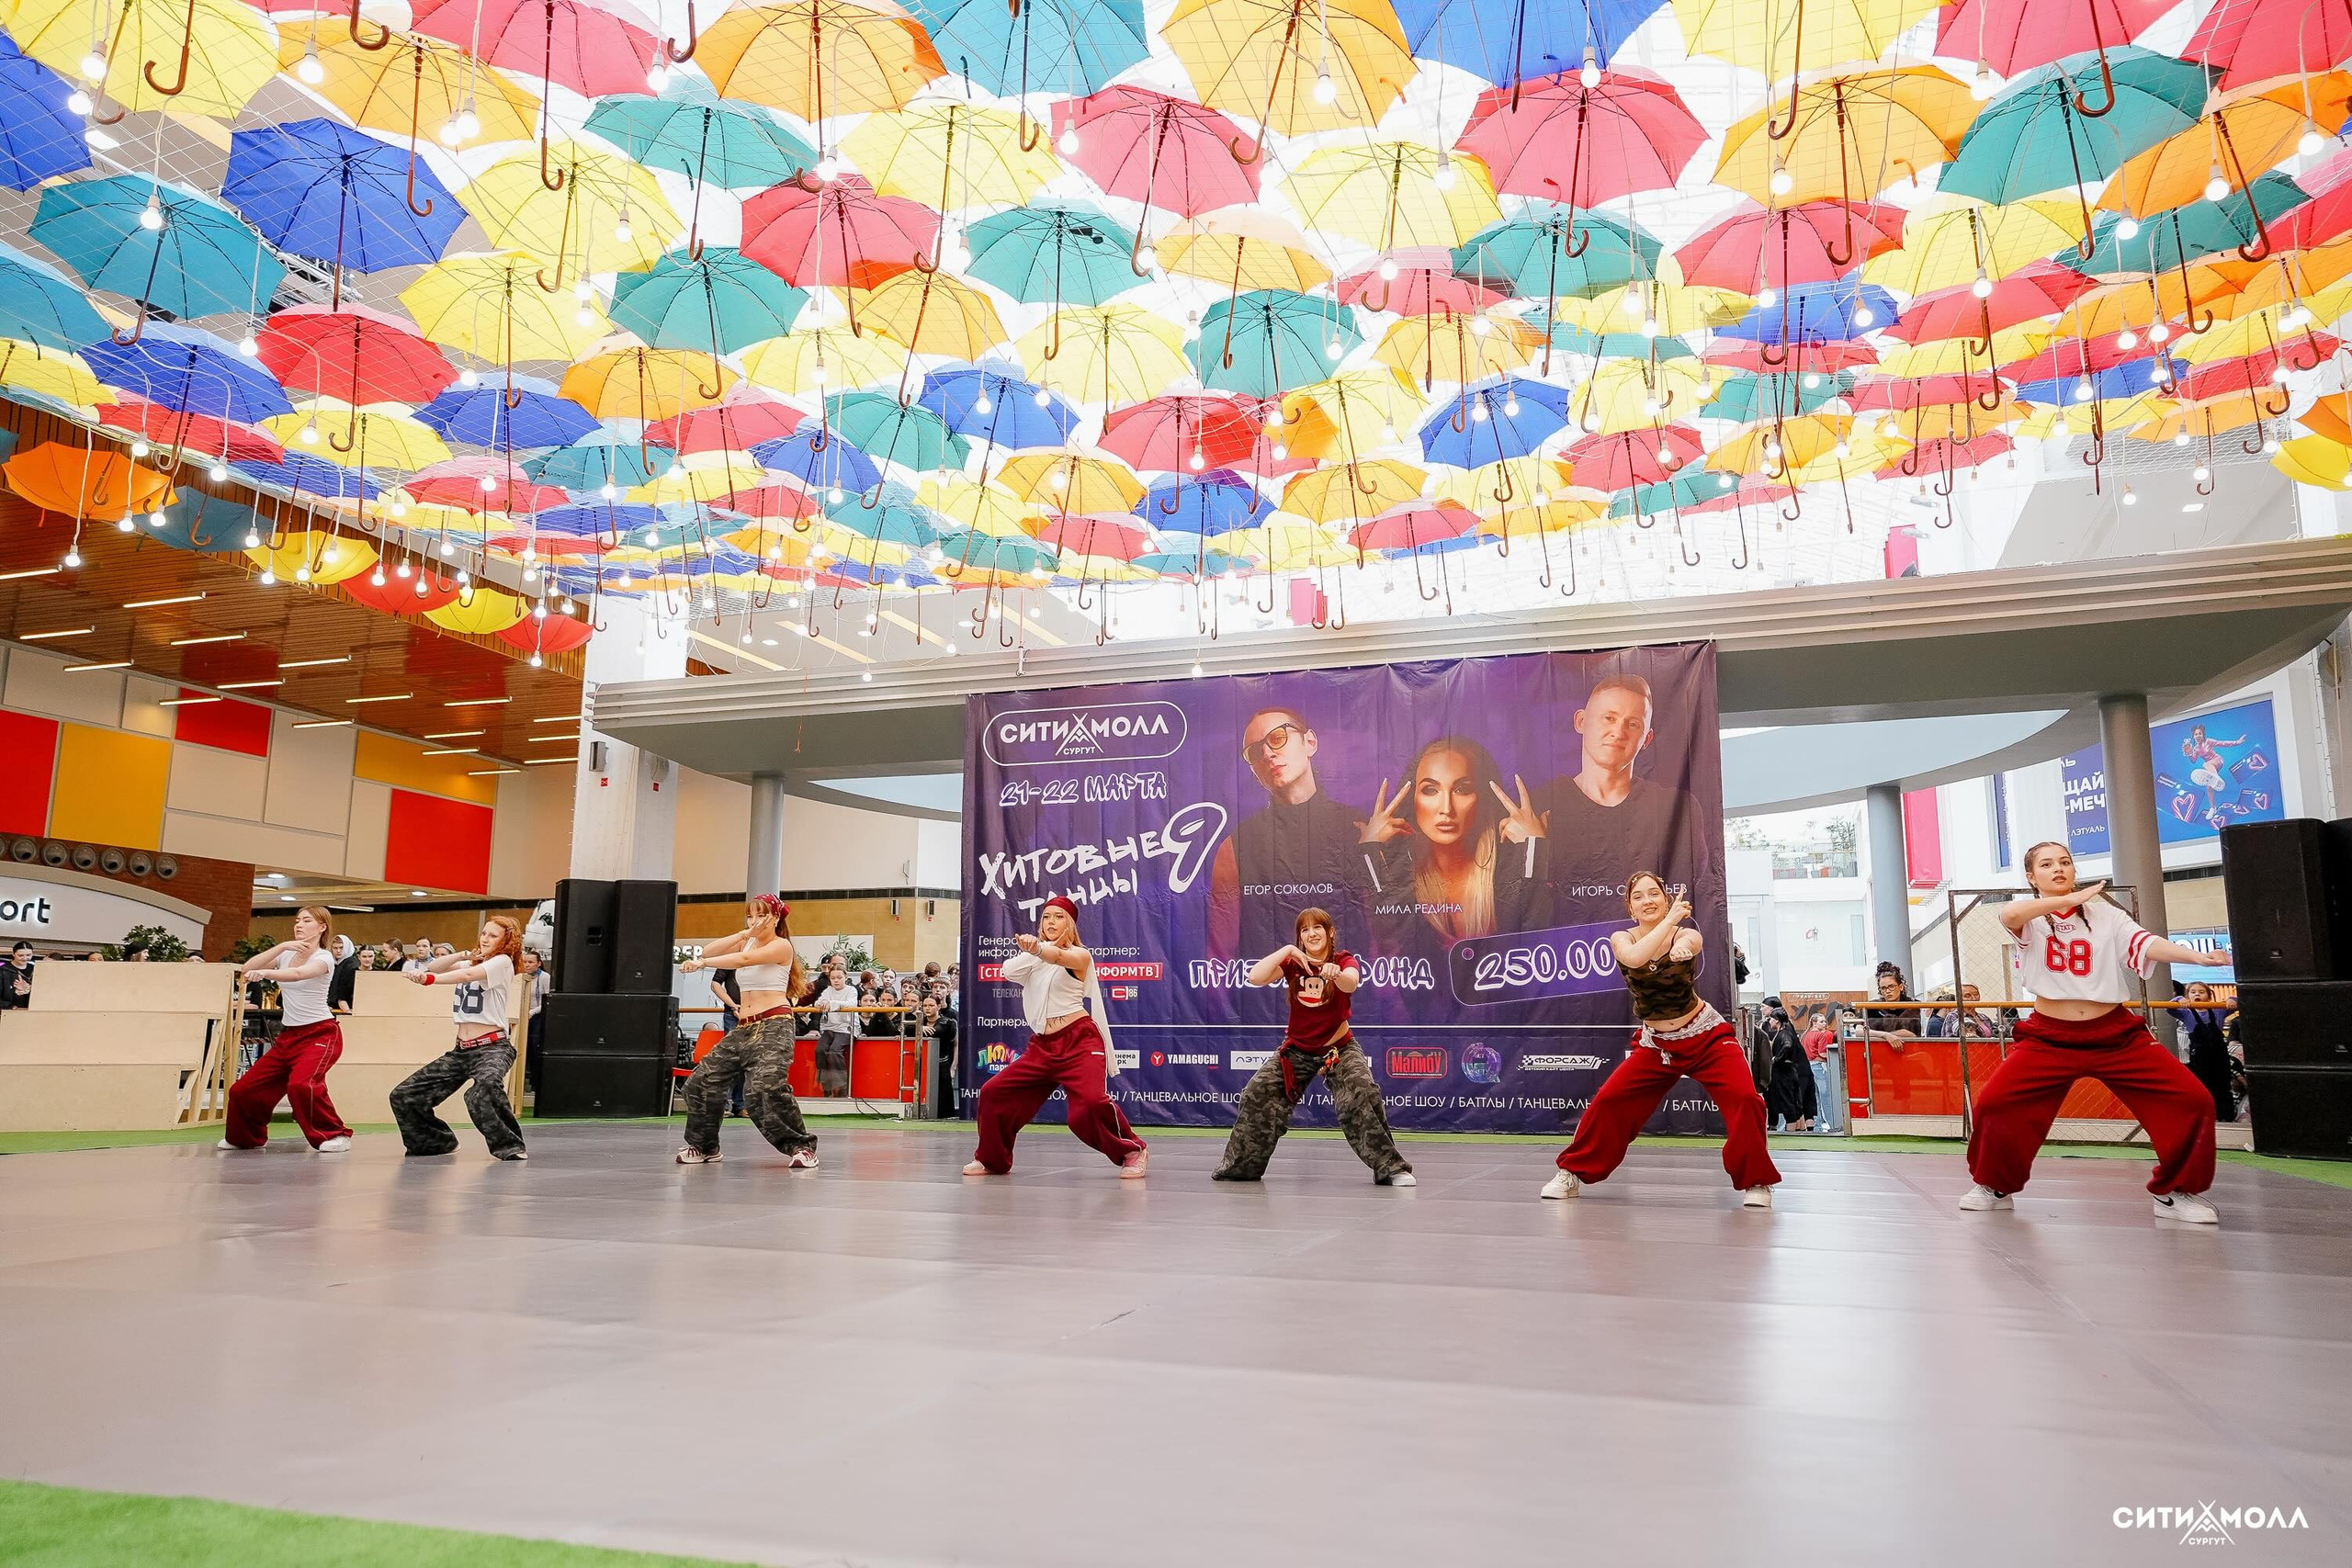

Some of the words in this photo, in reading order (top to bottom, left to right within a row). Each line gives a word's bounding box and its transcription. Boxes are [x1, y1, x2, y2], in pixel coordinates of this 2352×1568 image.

[1000, 720, 1069, 743] СИТИ
[1091, 714, 1170, 737] МОЛЛ
[1063, 746, 1096, 755] СУРГУТ
[999, 779, 1079, 807] 21-22
[1084, 772, 1168, 802] МАРТА
[2063, 771, 2105, 795] ЩАЙ
[2071, 825, 2106, 837] ЛЭТУАЛЬ
[978, 831, 1164, 900] ХИТОВЫЕ
[1243, 885, 1272, 896] ЕГОР
[1273, 883, 1333, 895] СОКОЛОВ
[1572, 885, 1613, 897] ИГОРЬ
[1617, 883, 1688, 897] СЬЕВ
[0, 897, 51, 924] ort
[1375, 904, 1412, 915] МИЛА
[1415, 903, 1463, 915] РЕДИНА
[2055, 923, 2077, 931] STATE
[2045, 934, 2094, 978] 68
[1474, 936, 1617, 991] 250.00
[992, 988, 1023, 998] ТЕЛЕКАН
[1167, 1054, 1219, 1065] YAMAGUCHI
[1236, 1056, 1268, 1065] ЛЭТУ
[1534, 1056, 1590, 1065] ФОРСАЖ
[1130, 1090, 1218, 1103] ТАНЦЕВАЛЬНОЕ
[1221, 1092, 1242, 1103] ШО
[1415, 1096, 1446, 1108] ШОУ
[1459, 1097, 1505, 1108] БАТТЛЫ
